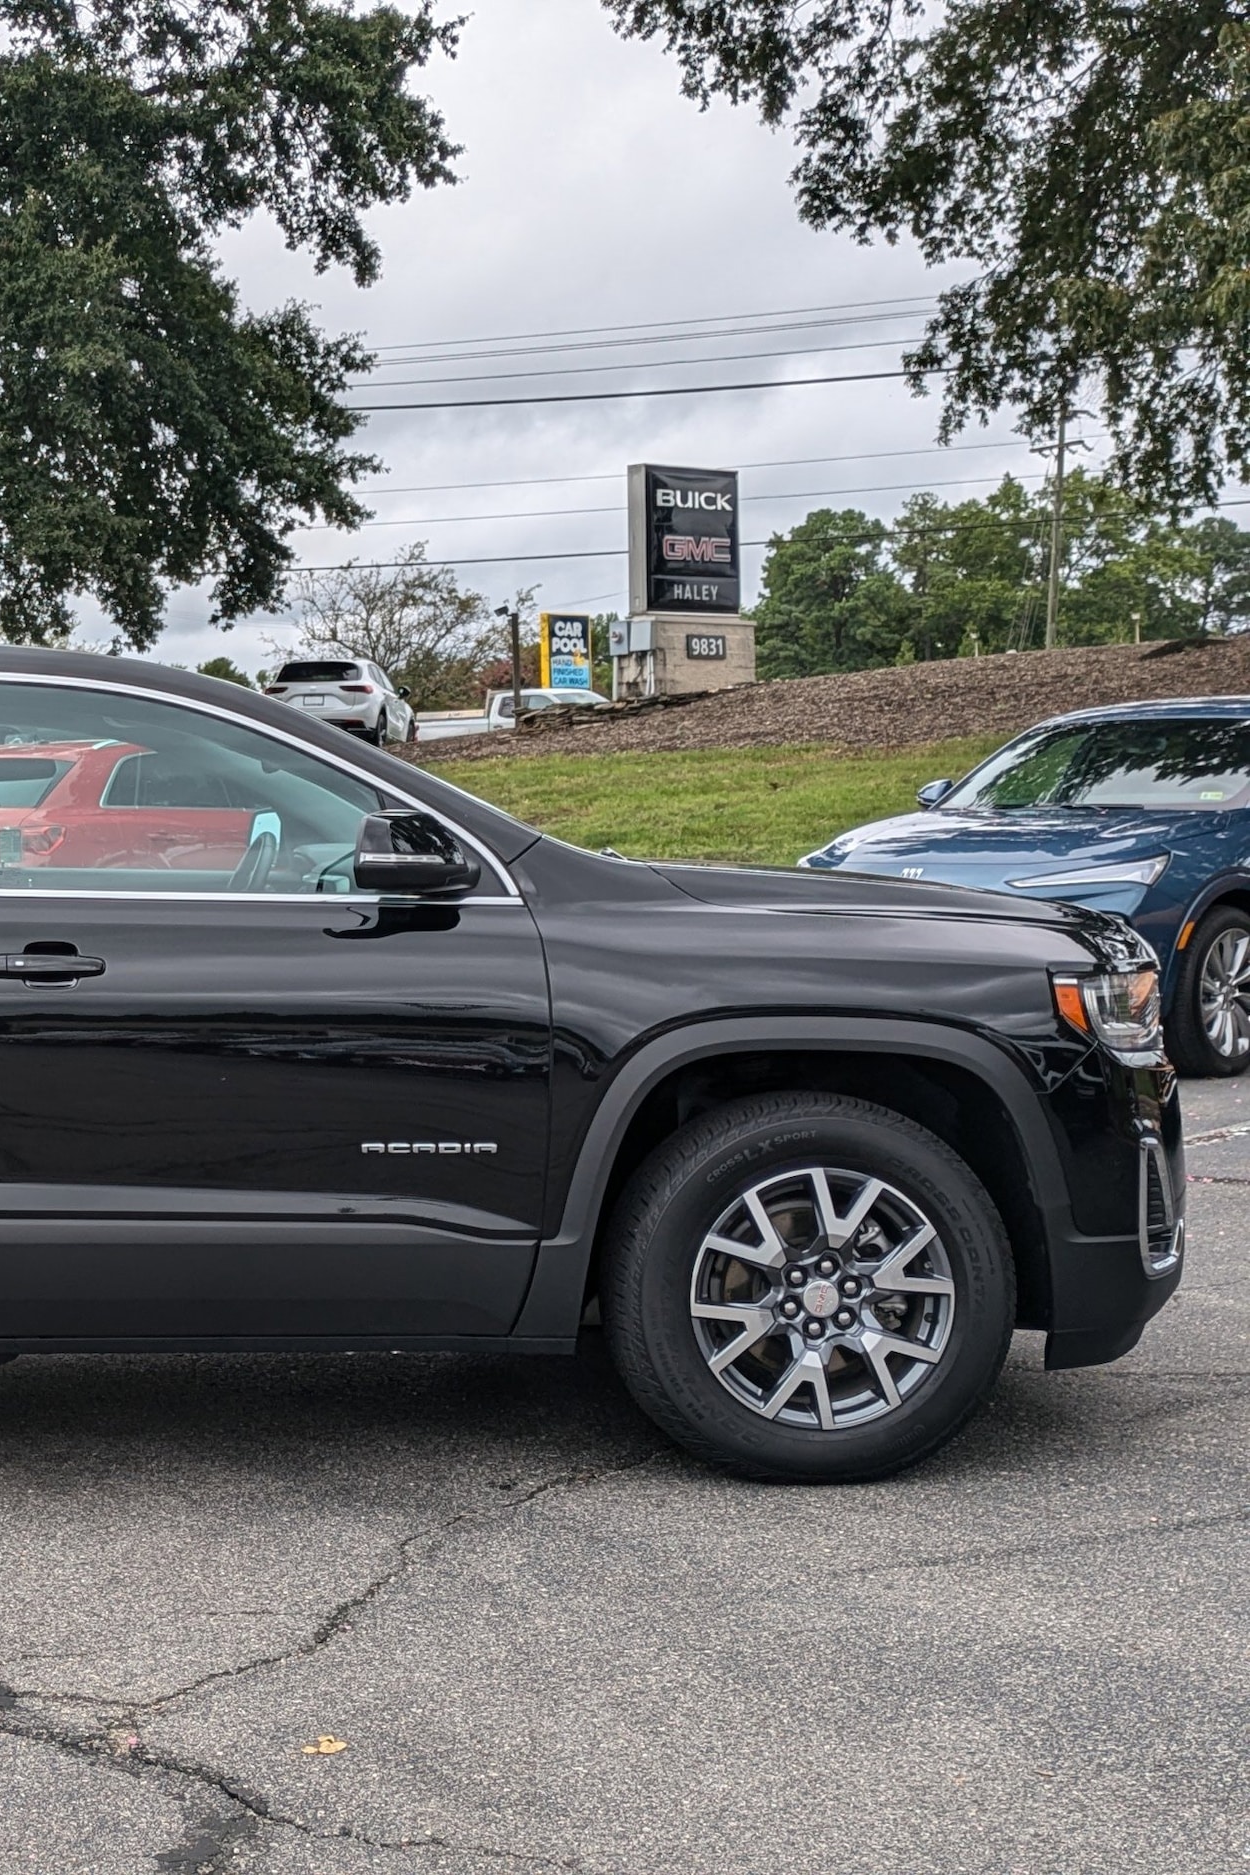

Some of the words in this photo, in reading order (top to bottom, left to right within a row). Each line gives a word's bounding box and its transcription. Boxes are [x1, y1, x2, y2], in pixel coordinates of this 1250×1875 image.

[656, 488, 733, 511] BUICK
[663, 534, 731, 563] GMC
[673, 584, 718, 601] HALEY
[554, 620, 583, 637] CAR
[551, 637, 588, 653] POOL
[691, 637, 724, 656] 9831
[553, 677, 567, 685] CAR
[568, 677, 587, 686] WASH
[361, 1142, 498, 1154] ACADIA
[706, 1152, 744, 1184] CROSS
[774, 1130, 817, 1145] SPORT
[814, 1285, 828, 1313] GMC
